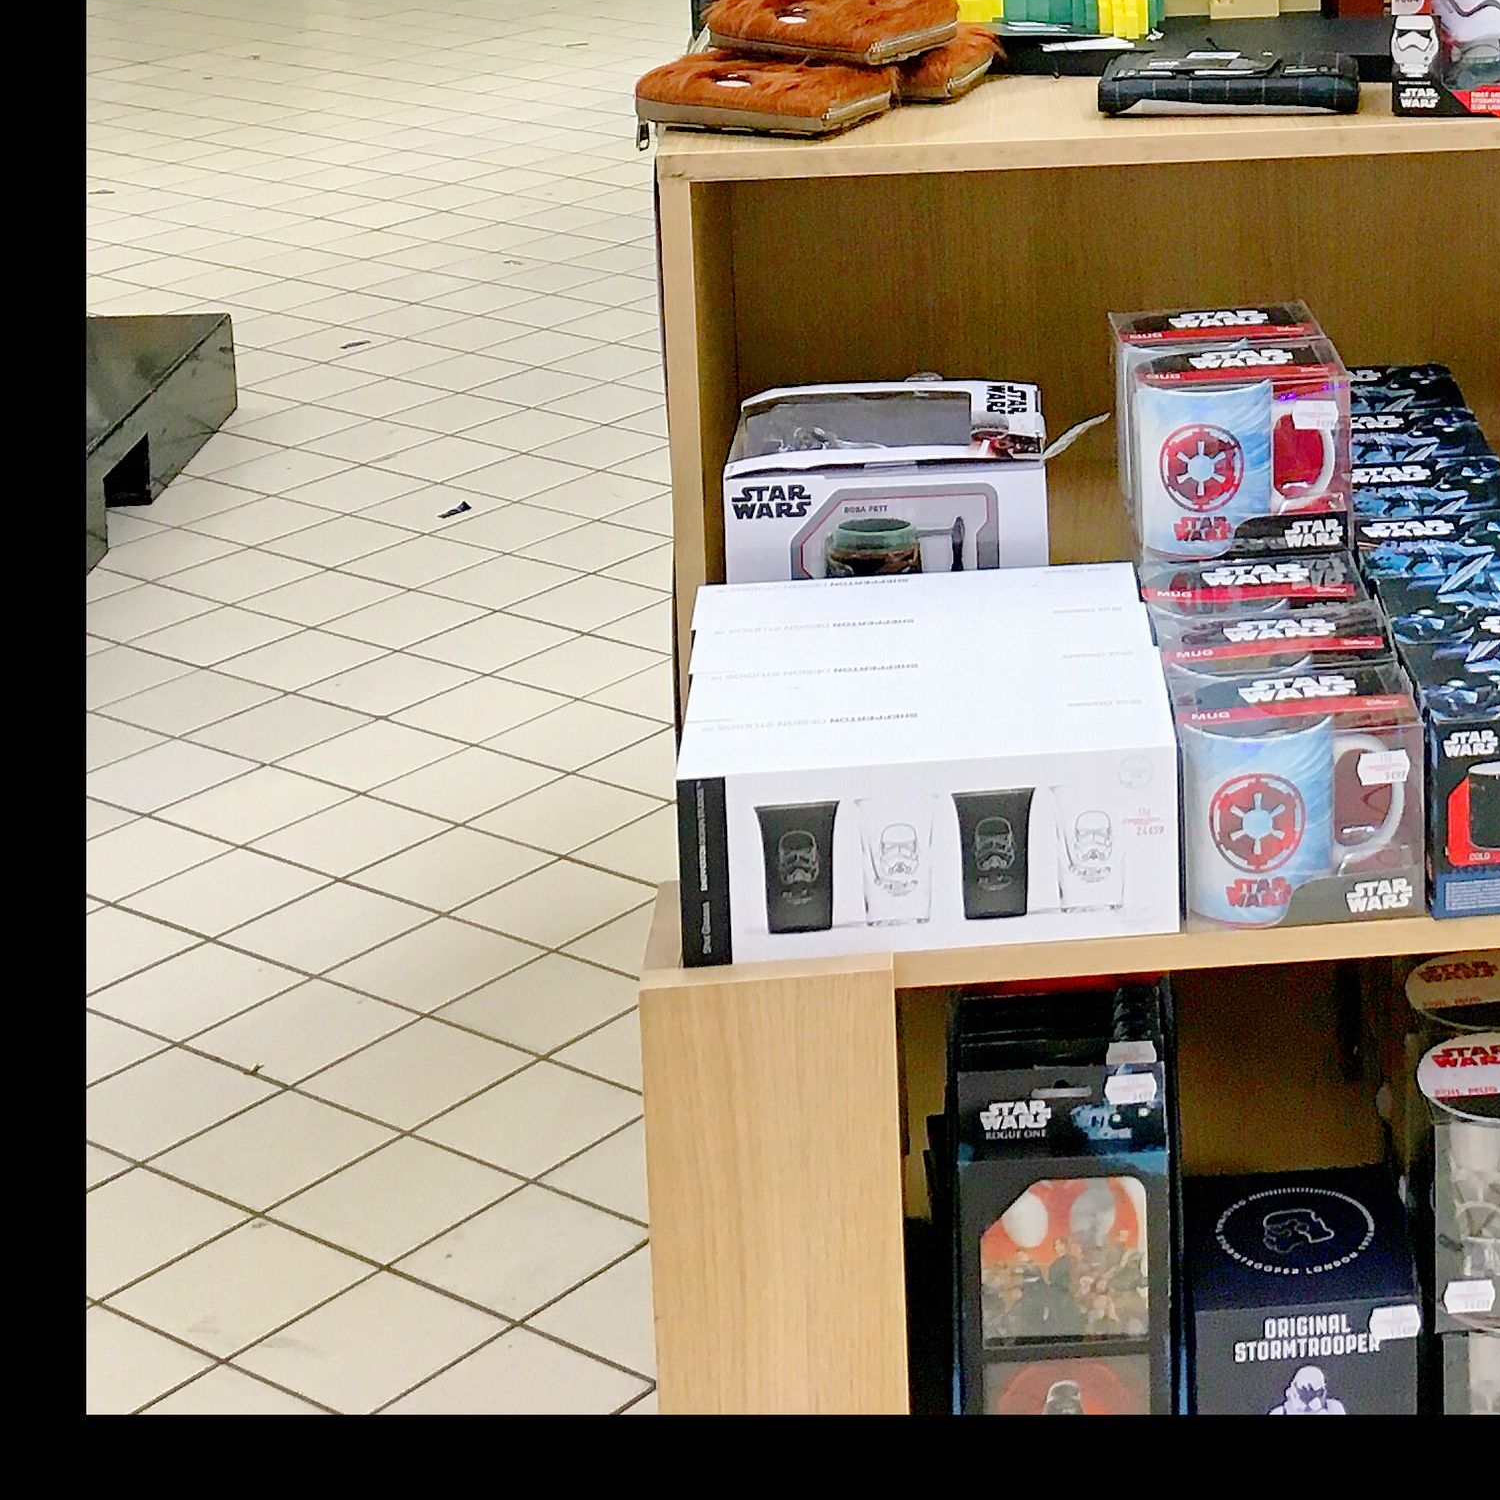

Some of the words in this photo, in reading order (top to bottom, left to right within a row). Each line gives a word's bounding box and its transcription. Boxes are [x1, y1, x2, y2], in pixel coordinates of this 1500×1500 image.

[1400, 88, 1440, 98] STAR
[1400, 98, 1440, 108] WARS
[1174, 310, 1269, 320] STAR
[1169, 317, 1268, 329] WARS
[1129, 332, 1163, 340] MUG
[1194, 349, 1293, 359] STAR
[1189, 356, 1293, 369] WARS
[986, 385, 1006, 414] WARS
[1007, 385, 1027, 414] STAR
[731, 484, 811, 503] STAR
[732, 502, 811, 520] WARS
[869, 505, 888, 513] FETT
[1285, 518, 1343, 534] STAR
[1366, 518, 1455, 530] STAR
[1285, 531, 1343, 548] WARS
[1361, 525, 1453, 539] WARS
[1204, 564, 1309, 576] STAR
[1201, 571, 1308, 586] WARS
[1157, 590, 1192, 598] MUG
[1227, 618, 1337, 631] STAR
[1223, 626, 1335, 642] WARS
[1176, 649, 1214, 658] MUG
[1242, 675, 1356, 690] STAR
[1237, 683, 1356, 703] WARS
[1190, 710, 1230, 720] MUG
[1443, 730, 1498, 746] STAR
[1443, 742, 1498, 757] WARS
[1468, 852, 1491, 861] COLD
[1226, 877, 1292, 895] STAR
[1346, 877, 1413, 896] STAR
[1346, 891, 1413, 912] WARS
[981, 1100, 1051, 1116] STAR
[980, 1111, 1051, 1131] WARS
[985, 1129, 1019, 1139] ROGUE
[1021, 1128, 1047, 1138] ONE
[1264, 1313, 1351, 1337] ORIGINAL
[1234, 1334, 1380, 1363] STORMTROOPER
